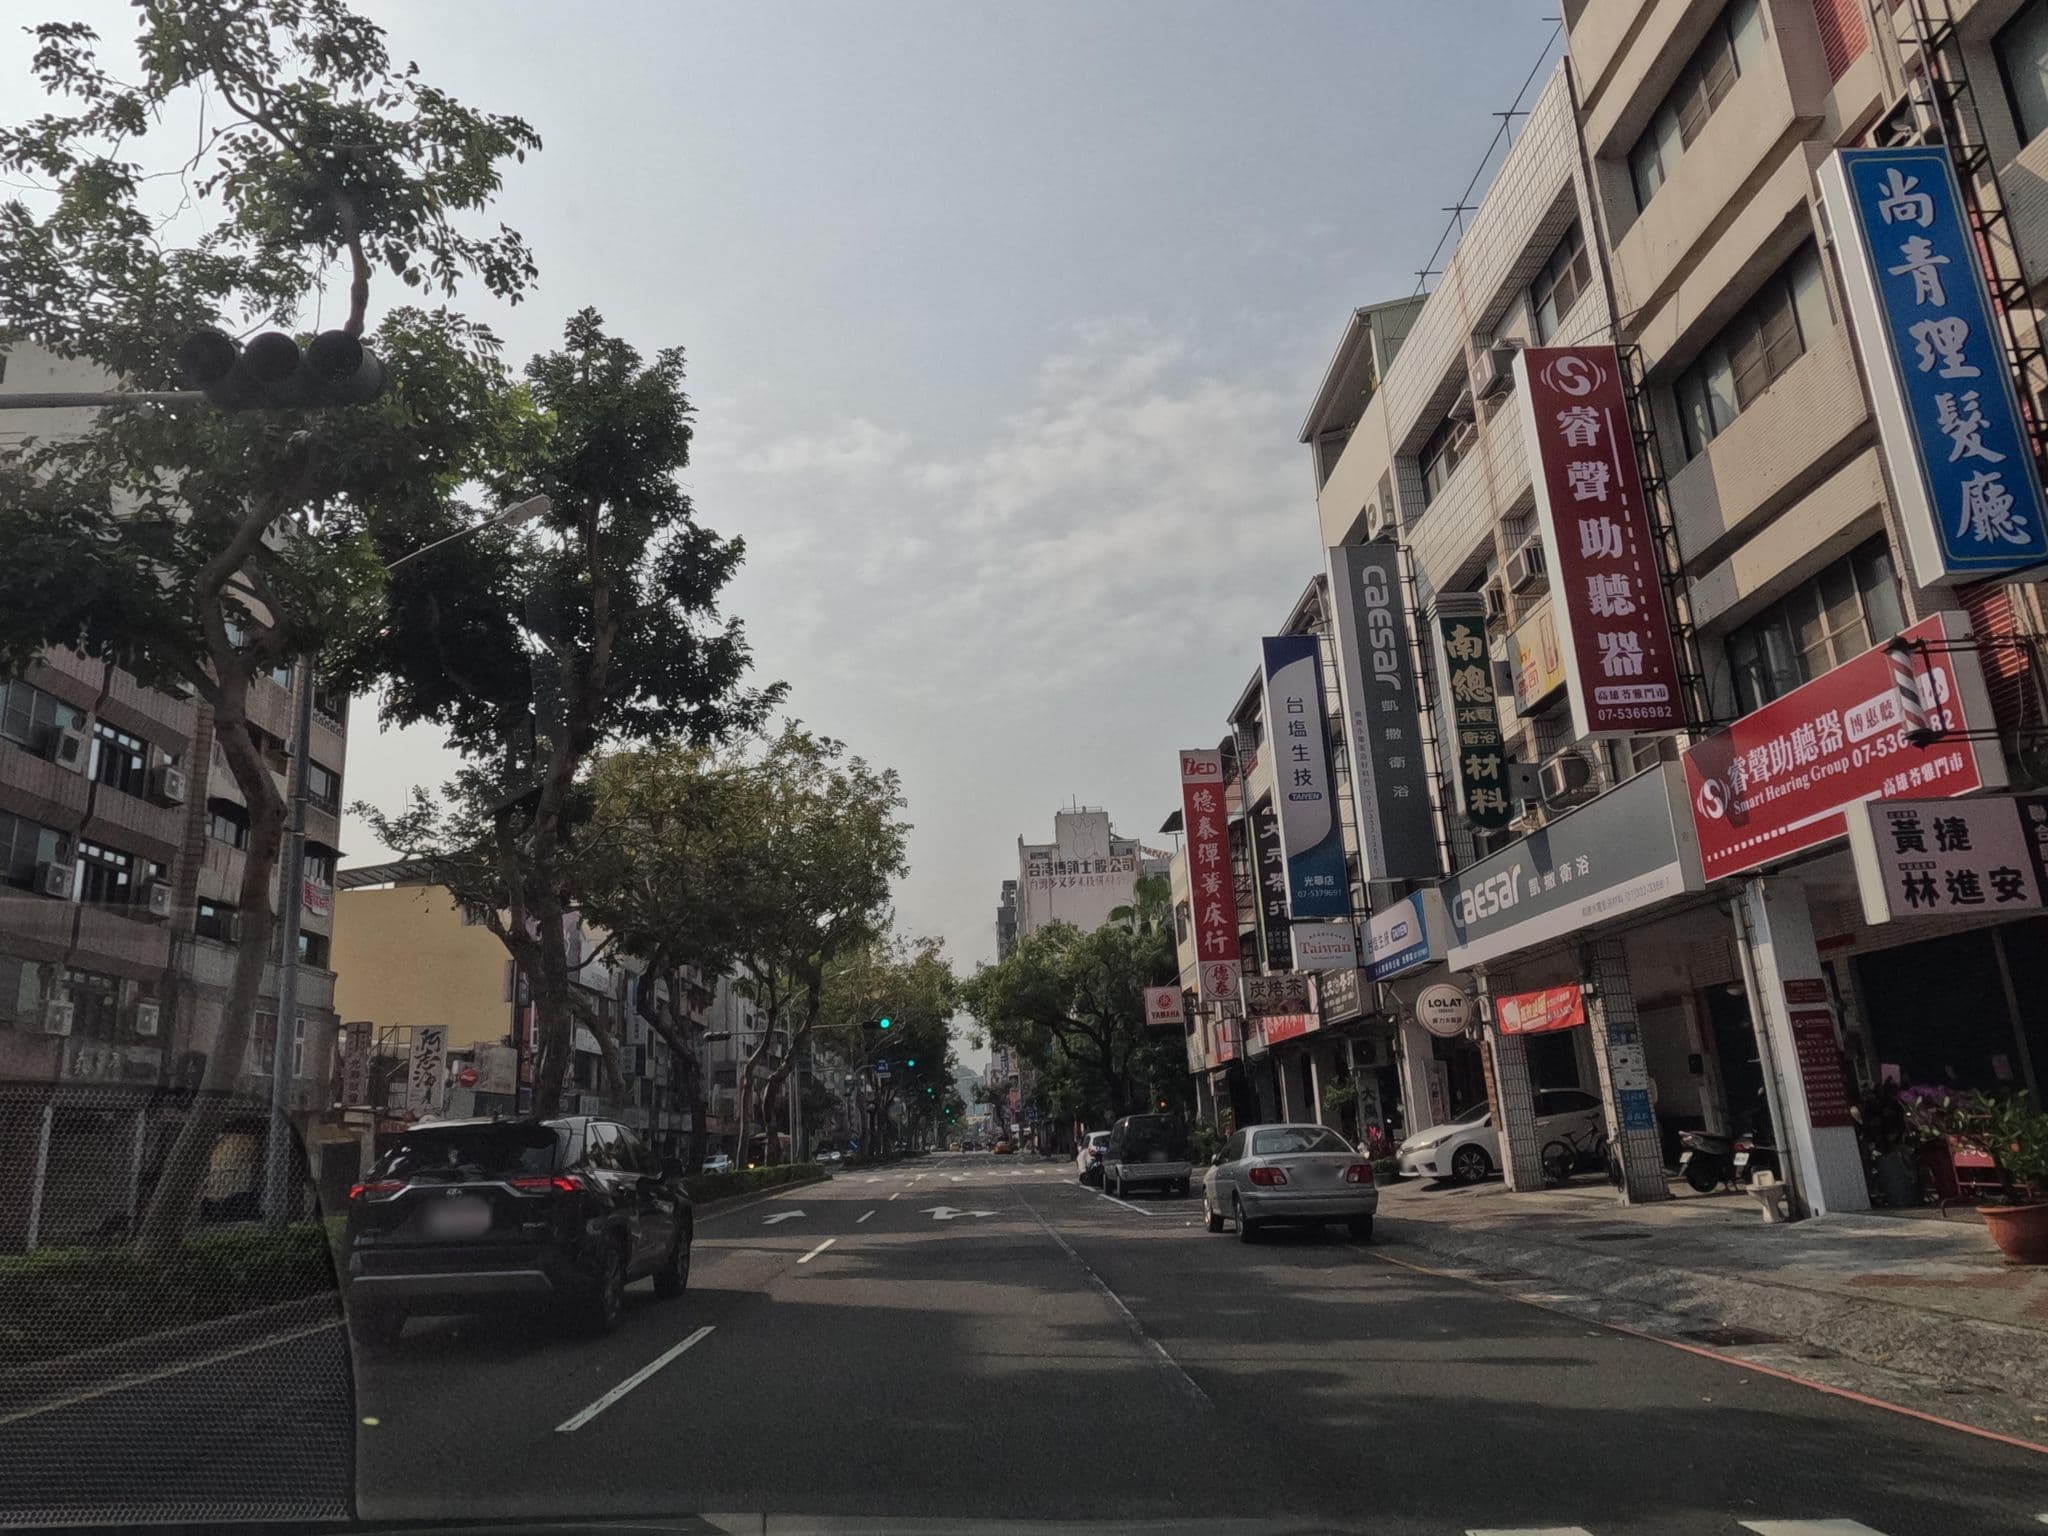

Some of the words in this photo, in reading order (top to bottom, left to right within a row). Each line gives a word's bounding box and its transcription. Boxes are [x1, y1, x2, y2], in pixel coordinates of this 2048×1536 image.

[1879, 168, 2031, 545] 尚青理髮廳
[1556, 406, 1643, 677] 睿聲助聽器
[1598, 706, 1672, 720] 07-5366982
[1728, 709, 1843, 795] 睿聲助聽器
[1465, 753, 1507, 815] 材料
[1733, 791, 1765, 815] Smart
[1765, 774, 1811, 802] Hearing
[1810, 757, 1849, 782] Group
[1901, 866, 2028, 909] 林進安
[1300, 941, 1351, 954] Taiwan
[1250, 978, 1302, 998] 炭焙茶
[1428, 998, 1462, 1008] LOLAT
[1151, 1010, 1180, 1019] YAMAHA
